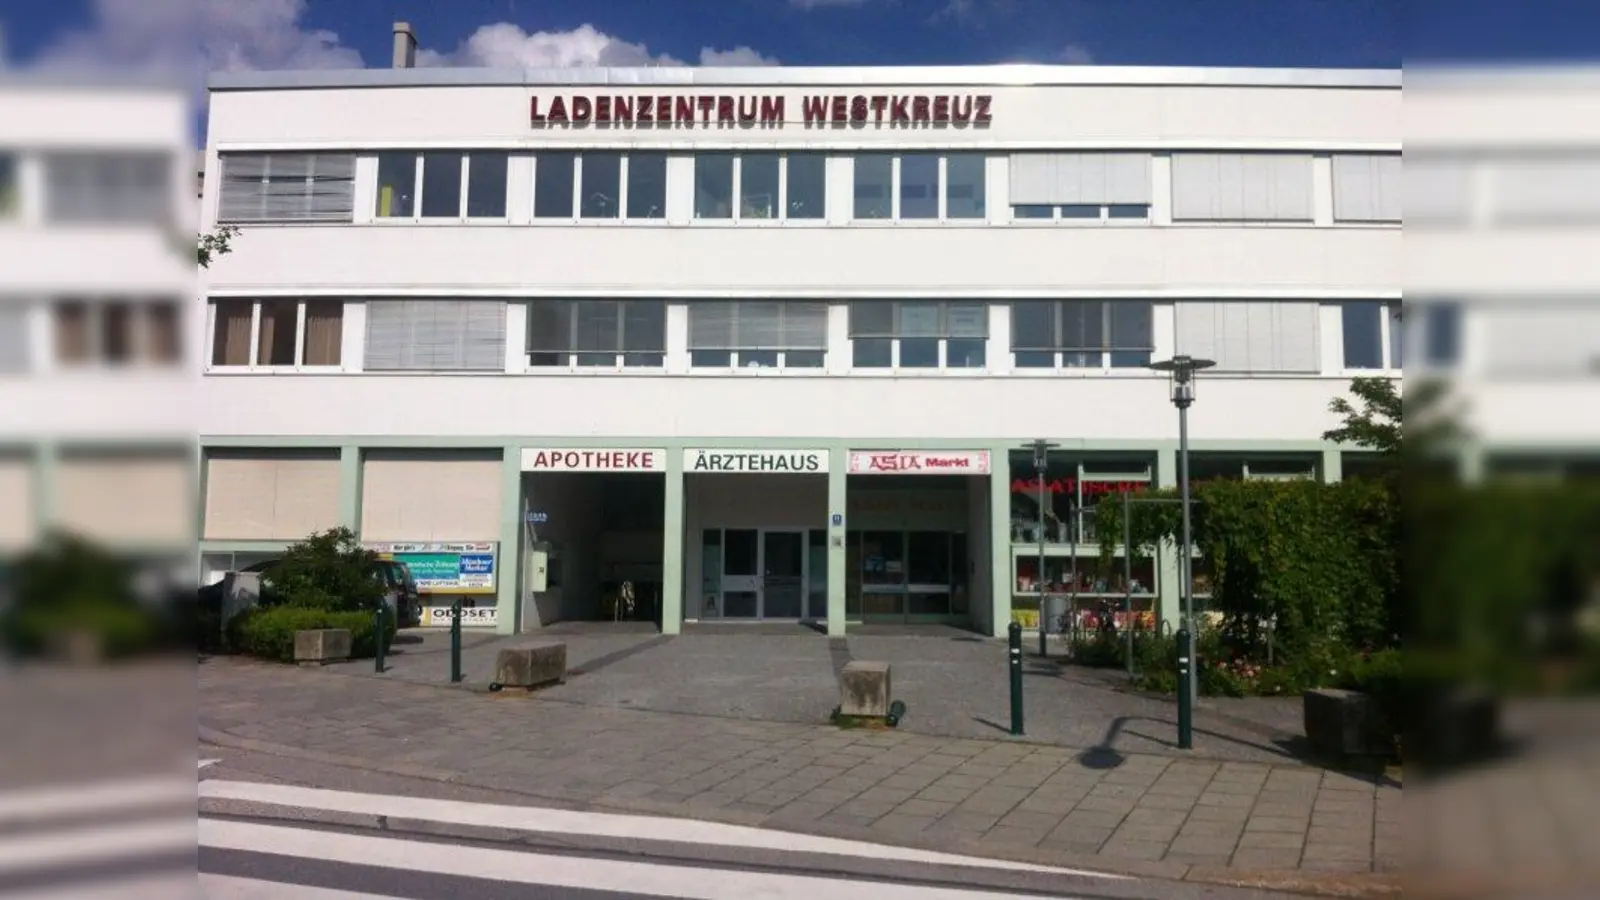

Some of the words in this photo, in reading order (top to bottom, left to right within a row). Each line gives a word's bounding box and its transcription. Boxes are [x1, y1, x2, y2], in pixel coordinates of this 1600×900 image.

[531, 95, 785, 126] LADENZENTRUM
[803, 95, 992, 126] WESTKREUZ
[534, 452, 653, 469] APOTHEKE
[695, 450, 819, 471] ÄRZTEHAUS
[869, 454, 922, 471] ASIA
[926, 457, 970, 468] Markt
[1012, 478, 1147, 494] ASATISCHE
